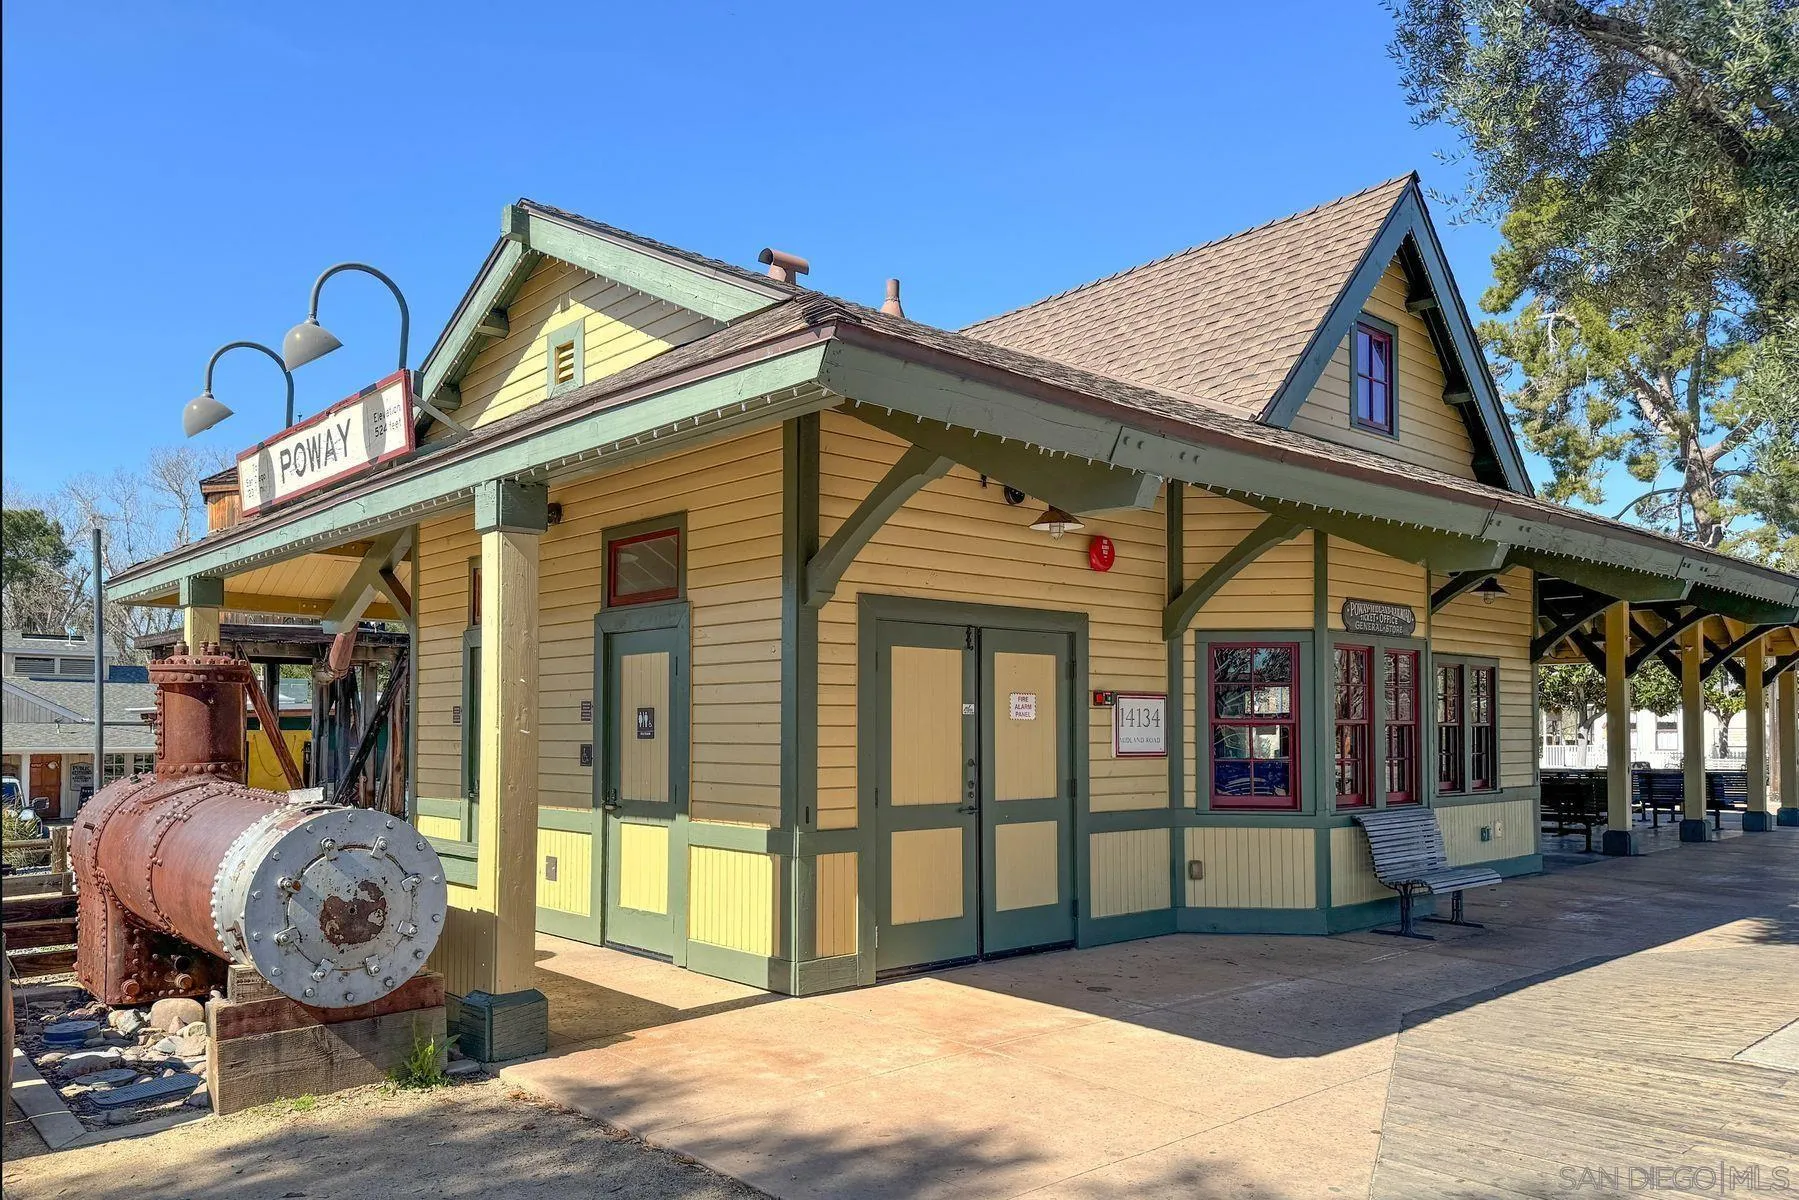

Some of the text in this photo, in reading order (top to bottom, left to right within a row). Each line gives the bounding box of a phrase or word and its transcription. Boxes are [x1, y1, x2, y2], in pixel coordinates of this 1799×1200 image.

[373, 403, 401, 423] Elevation
[375, 423, 388, 438] 524
[279, 418, 351, 484] POWAY
[1355, 621, 1403, 634] GENERAL STORE
[1379, 613, 1398, 625] OFFICE
[1119, 707, 1161, 728] 14134
